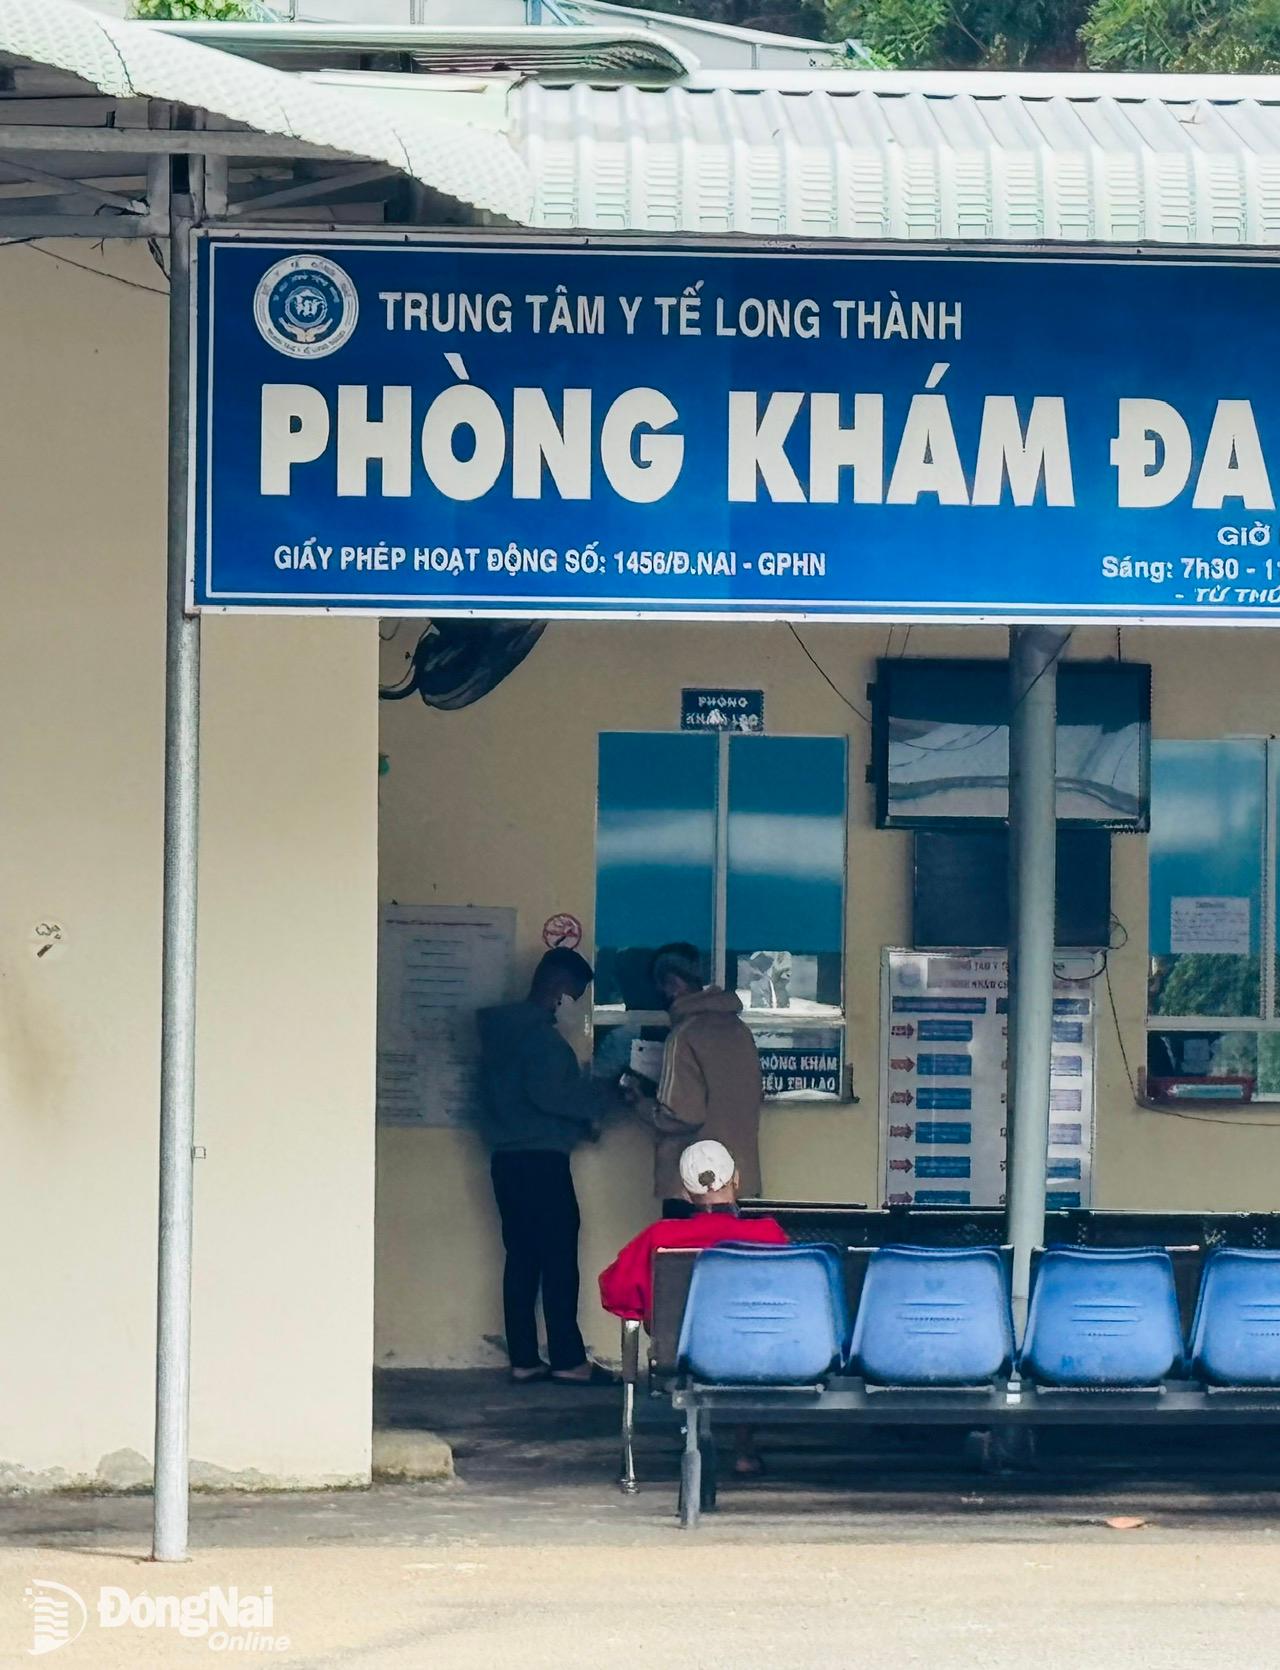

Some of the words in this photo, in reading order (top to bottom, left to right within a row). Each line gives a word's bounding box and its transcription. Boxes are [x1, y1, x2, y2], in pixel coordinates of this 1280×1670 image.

[378, 291, 512, 333] TRUNG
[525, 284, 605, 335] TÂM
[618, 296, 643, 335] Y
[654, 279, 705, 336] TẾ
[716, 297, 820, 339] LONG
[832, 290, 962, 340] THÀNH
[260, 352, 685, 504] PHÒNG
[727, 362, 1076, 507] KHÁM
[1109, 397, 1276, 511] ĐA
[1217, 521, 1271, 547] GIỜ
[274, 536, 333, 570] GIẤY
[340, 541, 406, 571] PHÉP
[413, 547, 481, 576] HOẠT
[486, 542, 558, 577] ĐỘNG
[565, 541, 606, 574] SỐ:
[757, 552, 826, 577] GPHN
[1102, 555, 1173, 584] Sáng:
[1180, 557, 1239, 580] 7h30
